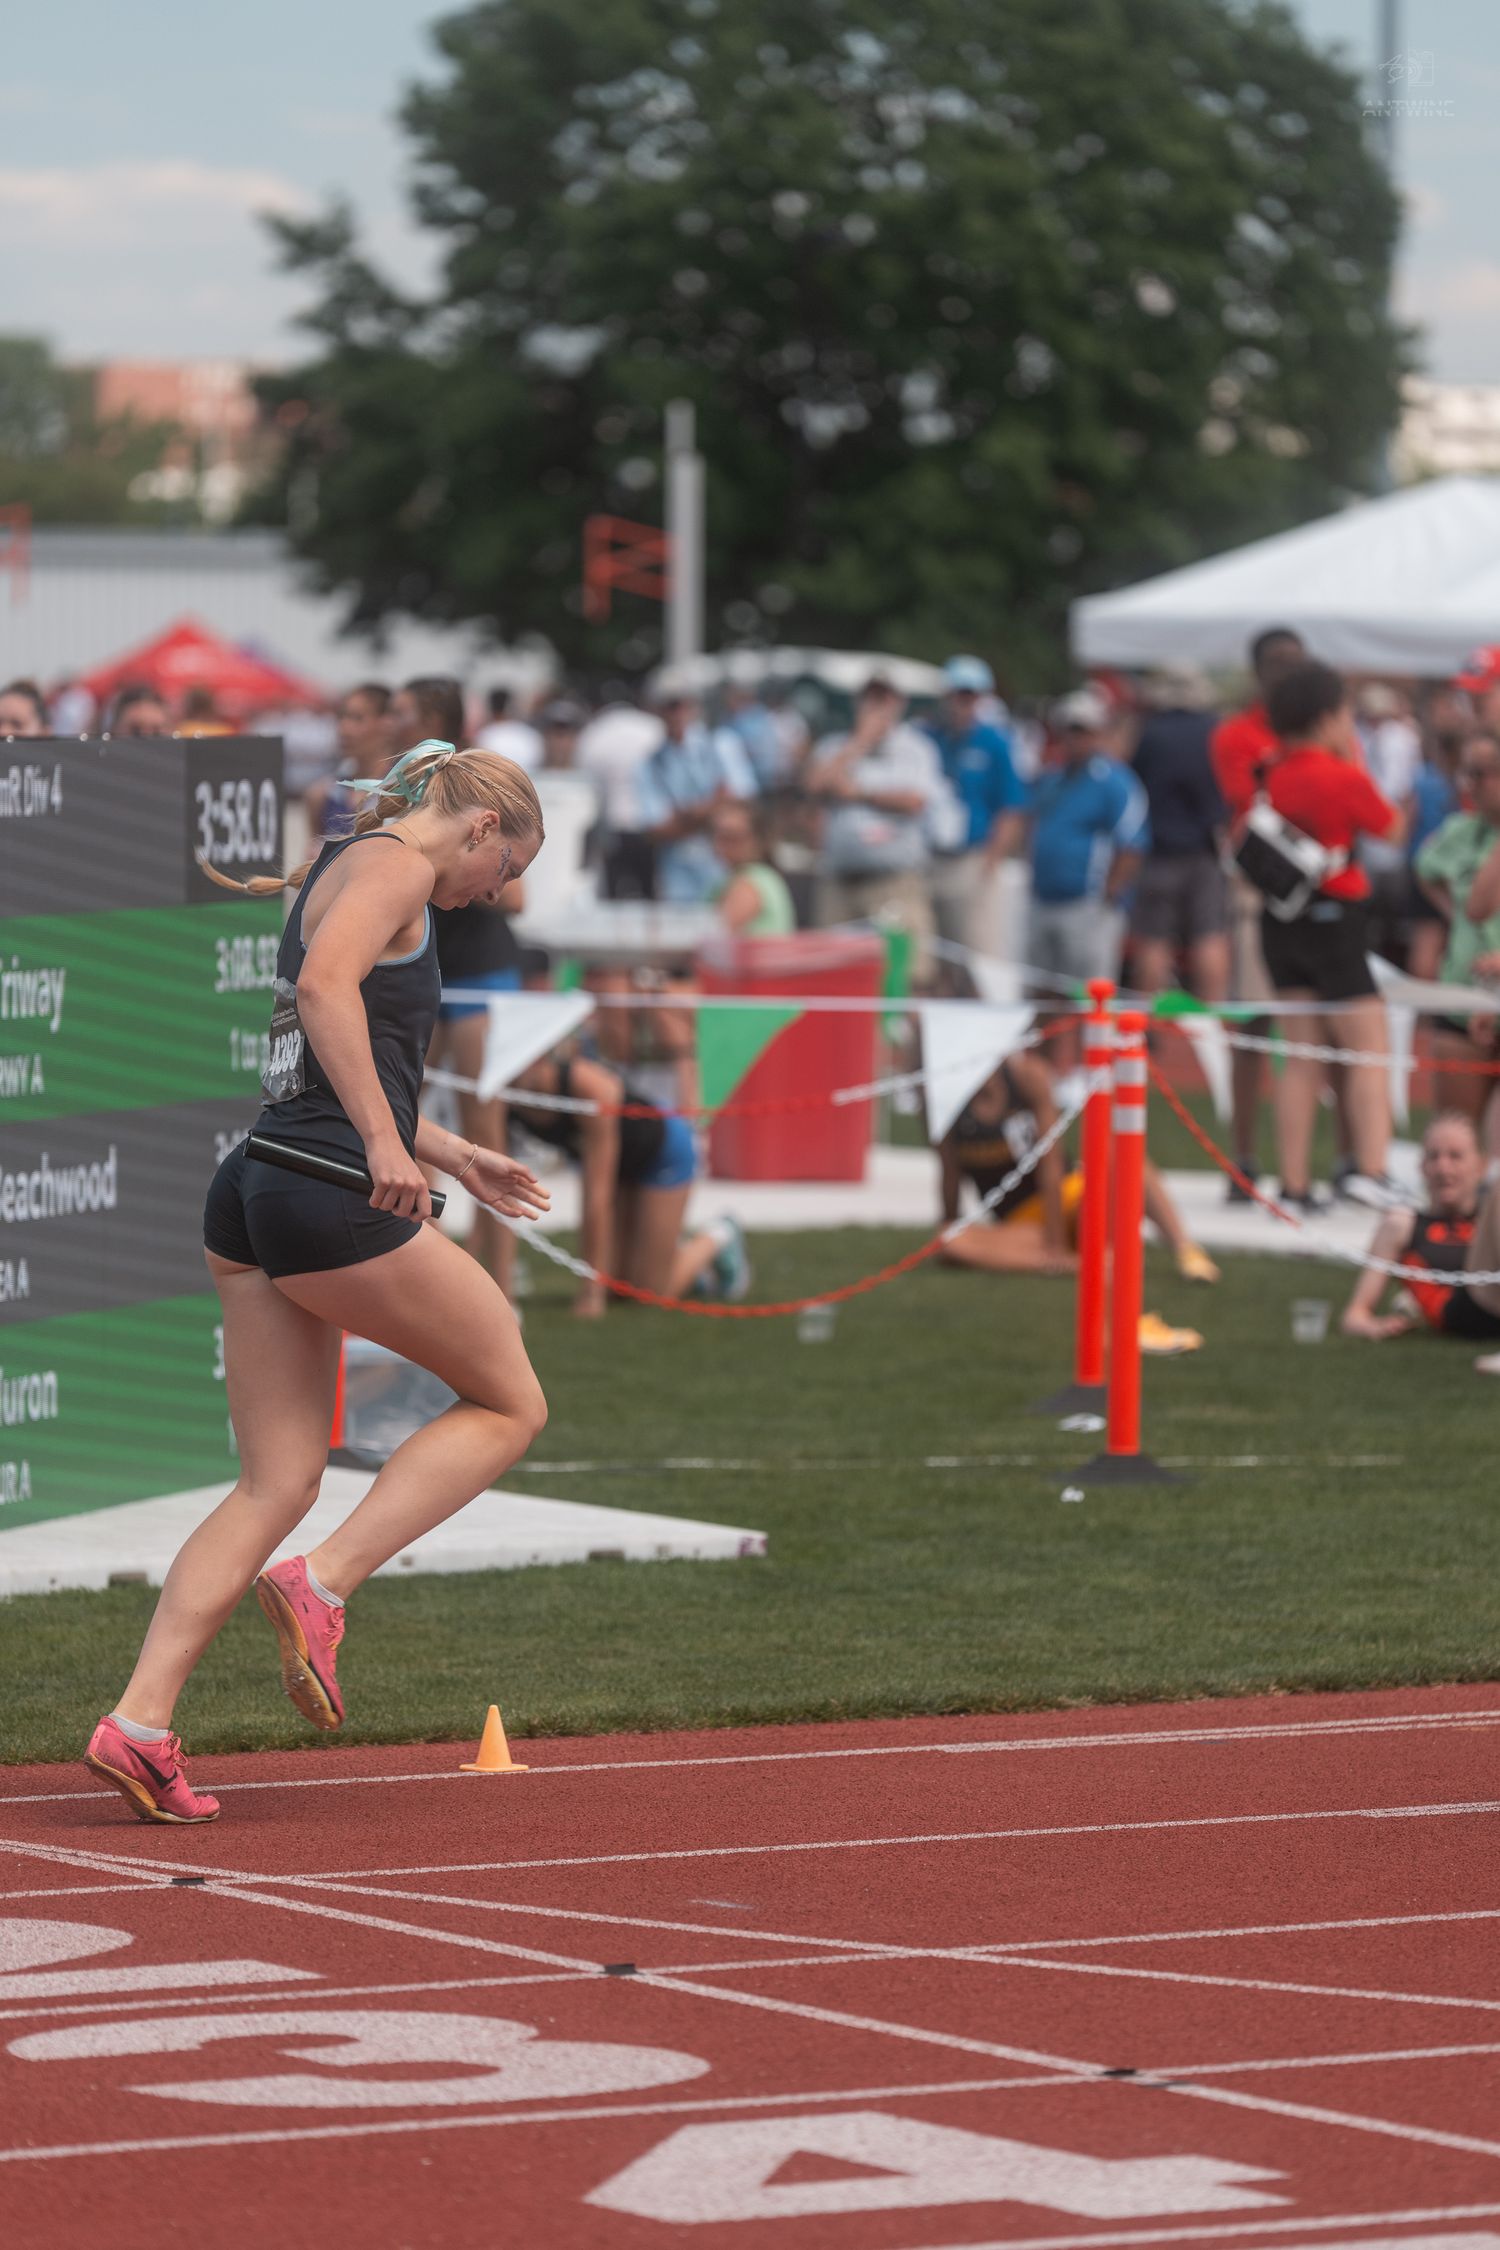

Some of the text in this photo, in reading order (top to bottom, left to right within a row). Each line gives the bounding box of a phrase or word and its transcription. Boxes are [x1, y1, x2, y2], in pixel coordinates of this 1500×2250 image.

[23, 764, 48, 818] Div
[50, 763, 63, 817] 4
[194, 779, 277, 863] 3:58.0
[0, 954, 66, 1034] riway
[31, 1052, 45, 1095] A
[0, 1144, 118, 1223] eachwood
[16, 1257, 30, 1299] A
[0, 1366, 59, 1426] uron
[20, 1459, 32, 1501] A
[6, 2010, 711, 2108] 3
[583, 2111, 1298, 2224] 4
